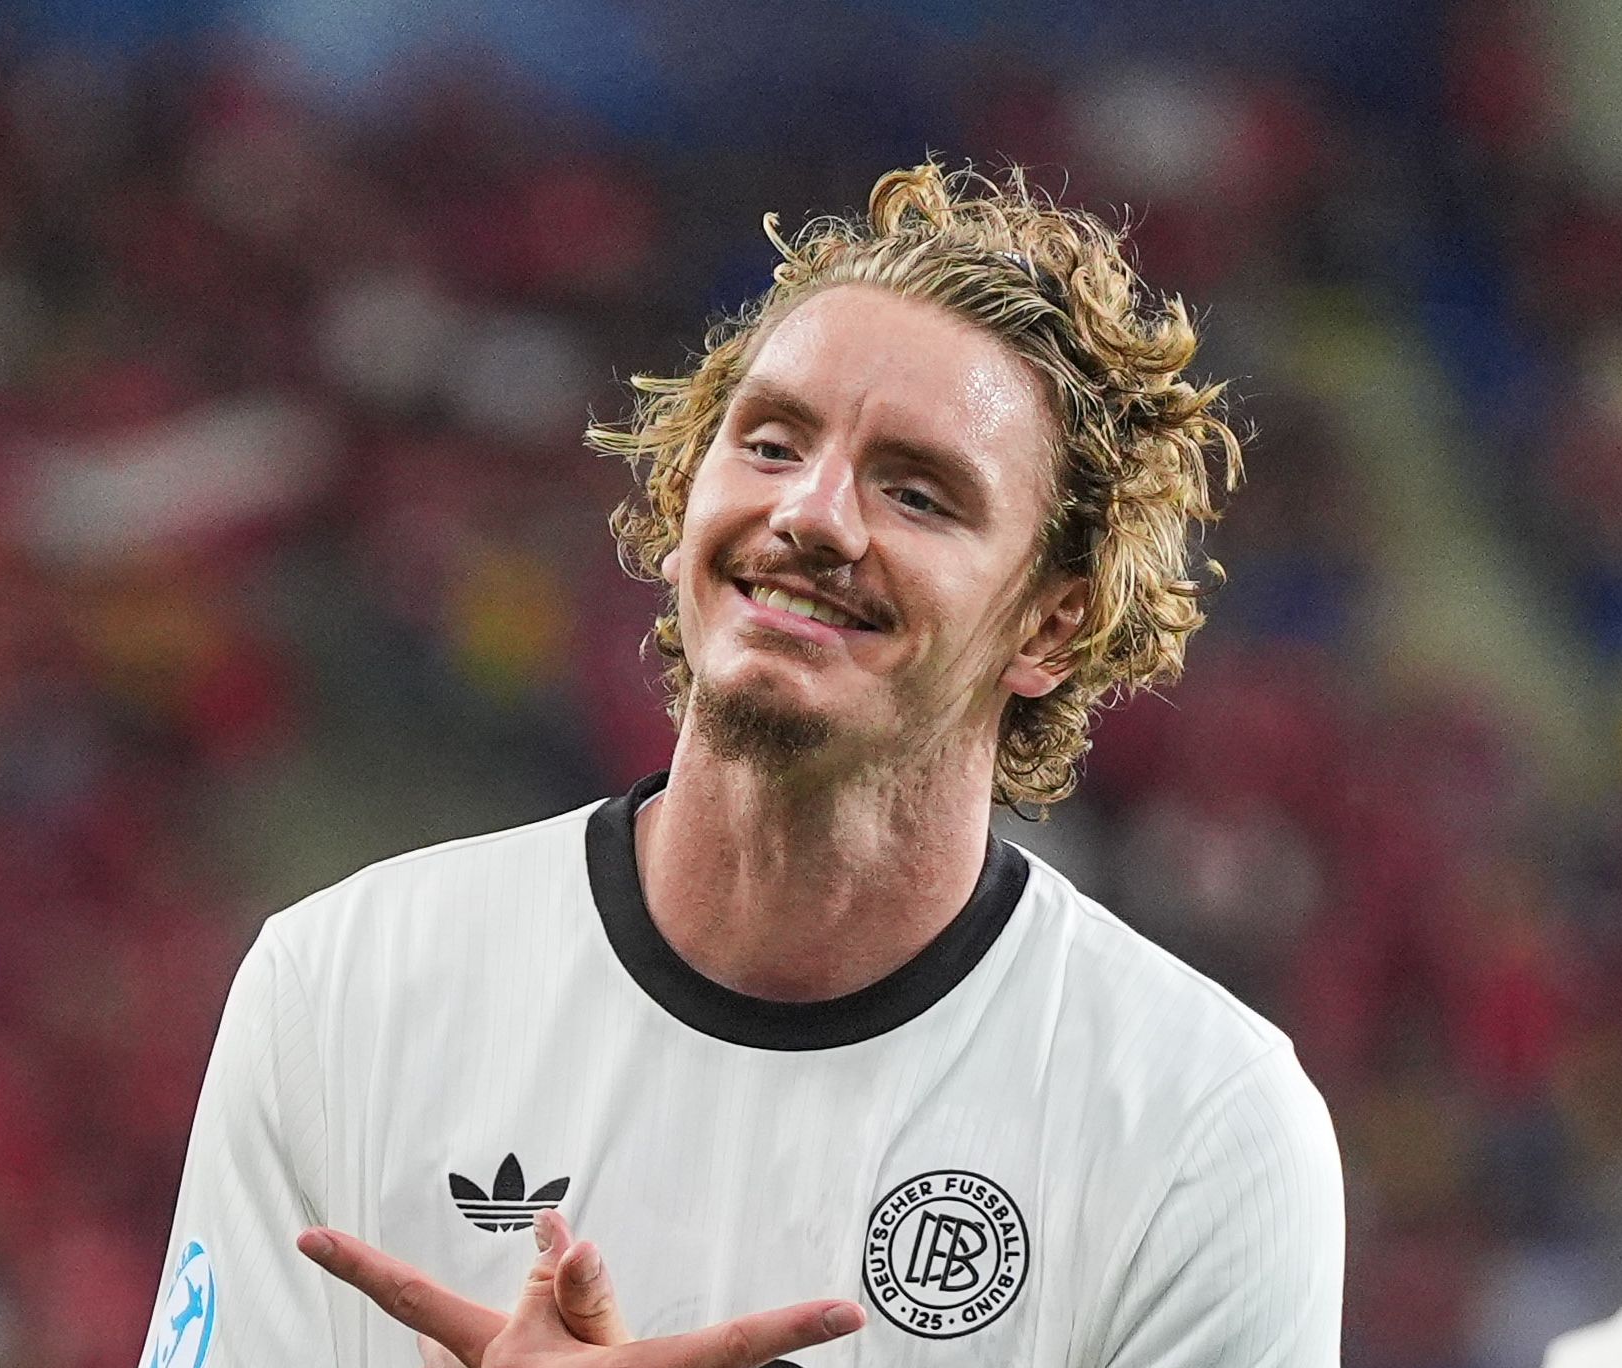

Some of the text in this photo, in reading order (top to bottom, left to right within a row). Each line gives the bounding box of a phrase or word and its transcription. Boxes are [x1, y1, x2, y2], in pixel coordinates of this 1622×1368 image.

[869, 1176, 1021, 1324] DEUTSCHER FUSSBALL-BUND
[908, 1307, 943, 1331] 125
